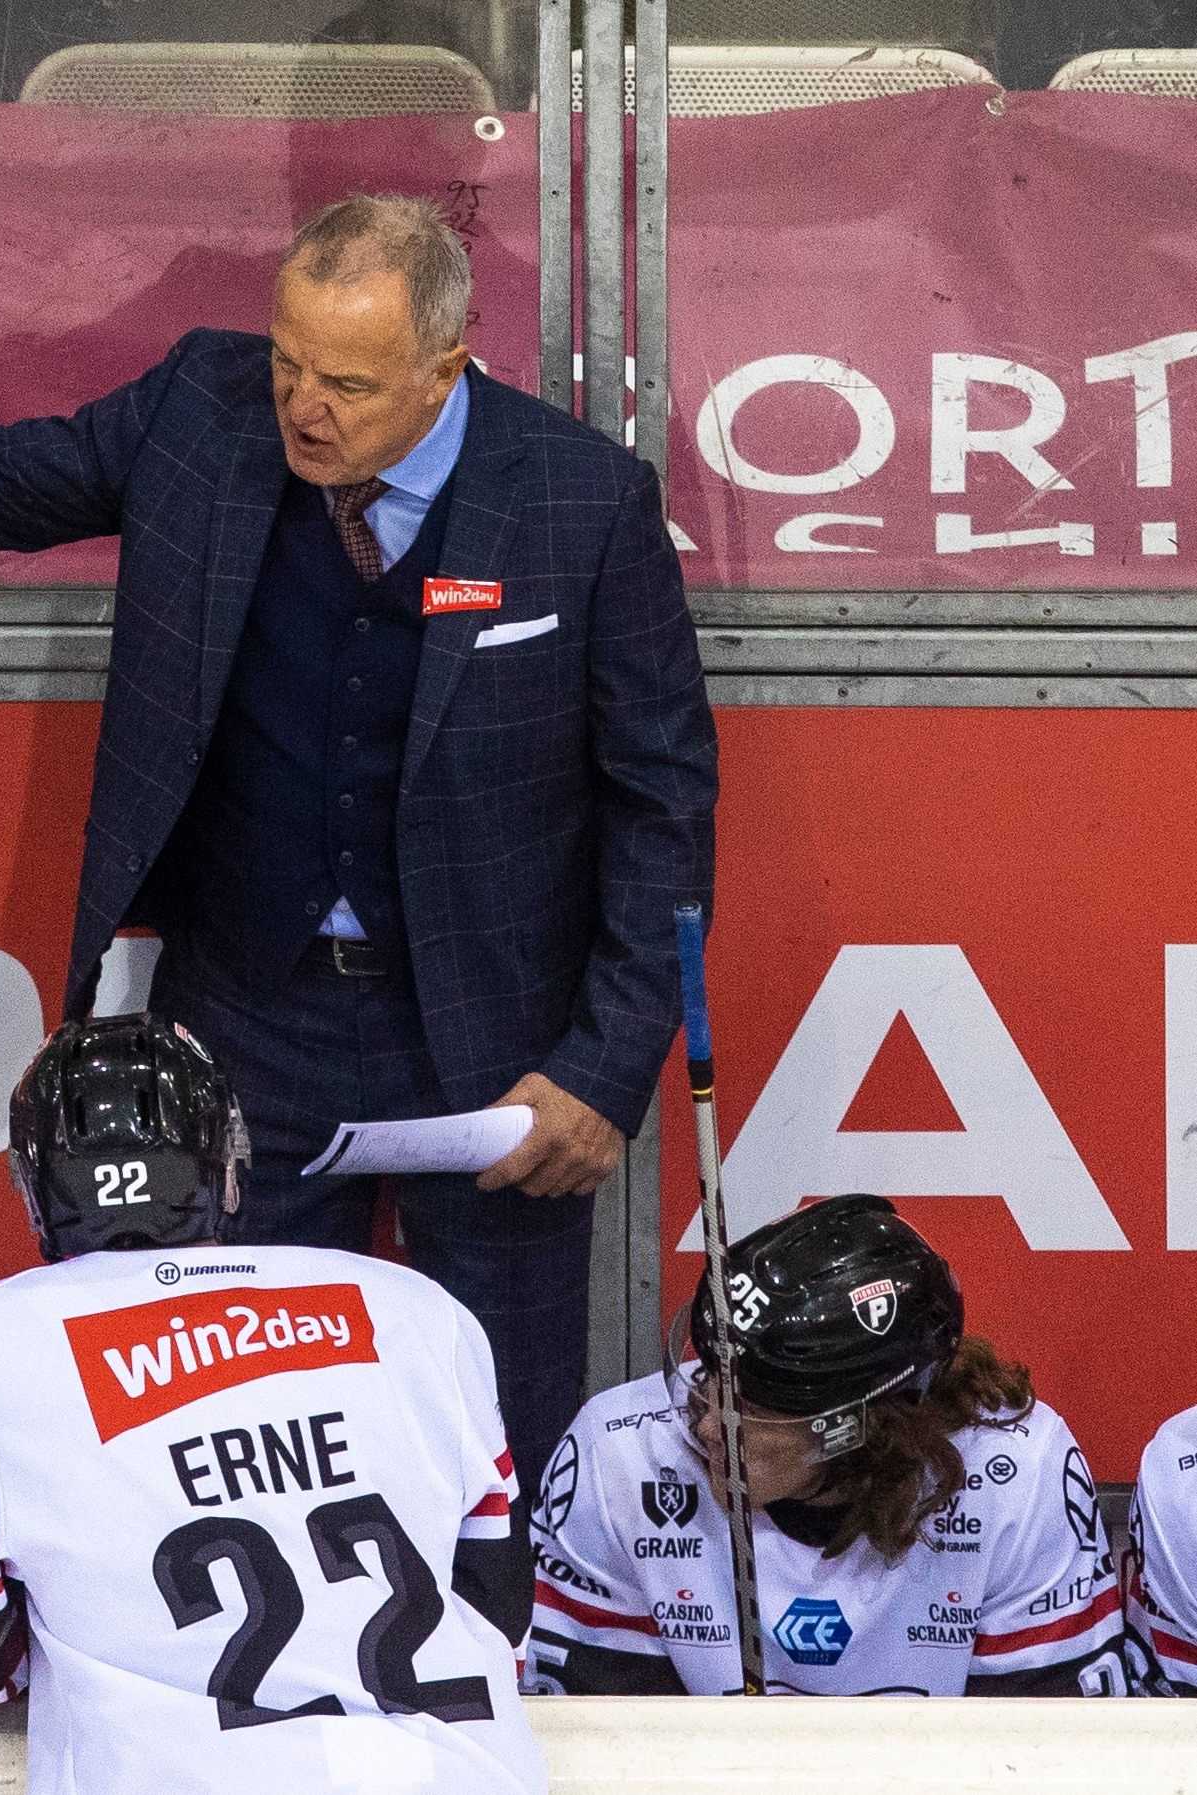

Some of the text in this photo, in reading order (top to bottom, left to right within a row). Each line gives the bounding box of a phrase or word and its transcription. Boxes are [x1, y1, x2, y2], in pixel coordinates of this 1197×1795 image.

[573, 330, 1197, 495] ORT
[431, 586, 494, 606] win2day
[676, 944, 1197, 1252] A
[94, 1161, 151, 1207] 22
[184, 1264, 257, 1277] WARRIOR
[729, 1272, 771, 1332] 25
[868, 1296, 888, 1329] P
[103, 1306, 351, 1399] win2day
[167, 1411, 356, 1507] ERNE
[934, 1512, 982, 1535] side
[633, 1537, 703, 1559] GRAWE
[946, 1542, 981, 1554] GRAWE
[152, 1492, 495, 1731] 22
[653, 1601, 714, 1622] CASINO
[776, 1614, 845, 1652] ICE
